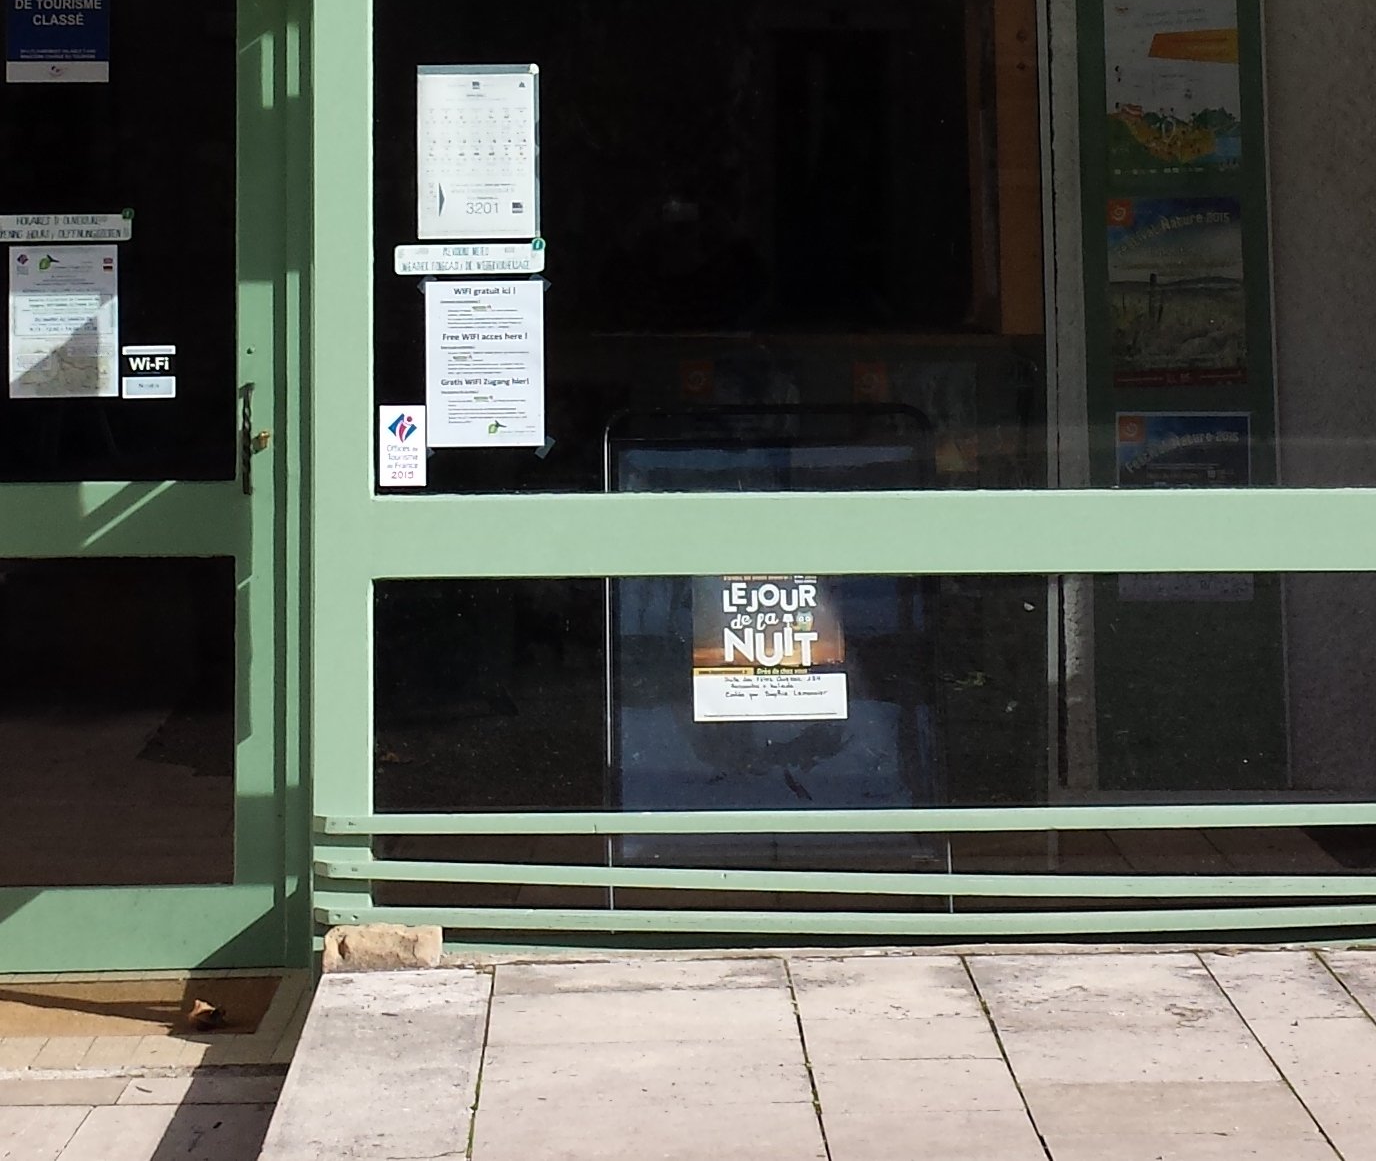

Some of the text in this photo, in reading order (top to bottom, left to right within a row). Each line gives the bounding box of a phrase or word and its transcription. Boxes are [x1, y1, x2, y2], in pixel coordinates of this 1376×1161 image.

[32, 12, 85, 26] CLASSÉ
[465, 202, 500, 215] 3201
[473, 286, 500, 296] gratuit
[442, 333, 460, 341] Free
[504, 332, 523, 341] here
[129, 356, 170, 371] Wi-Fi
[440, 378, 464, 386] Gratis
[483, 377, 510, 388] Zugang
[722, 582, 817, 613] LE JOUR
[730, 612, 779, 631] de la
[723, 627, 818, 667] NUIT
